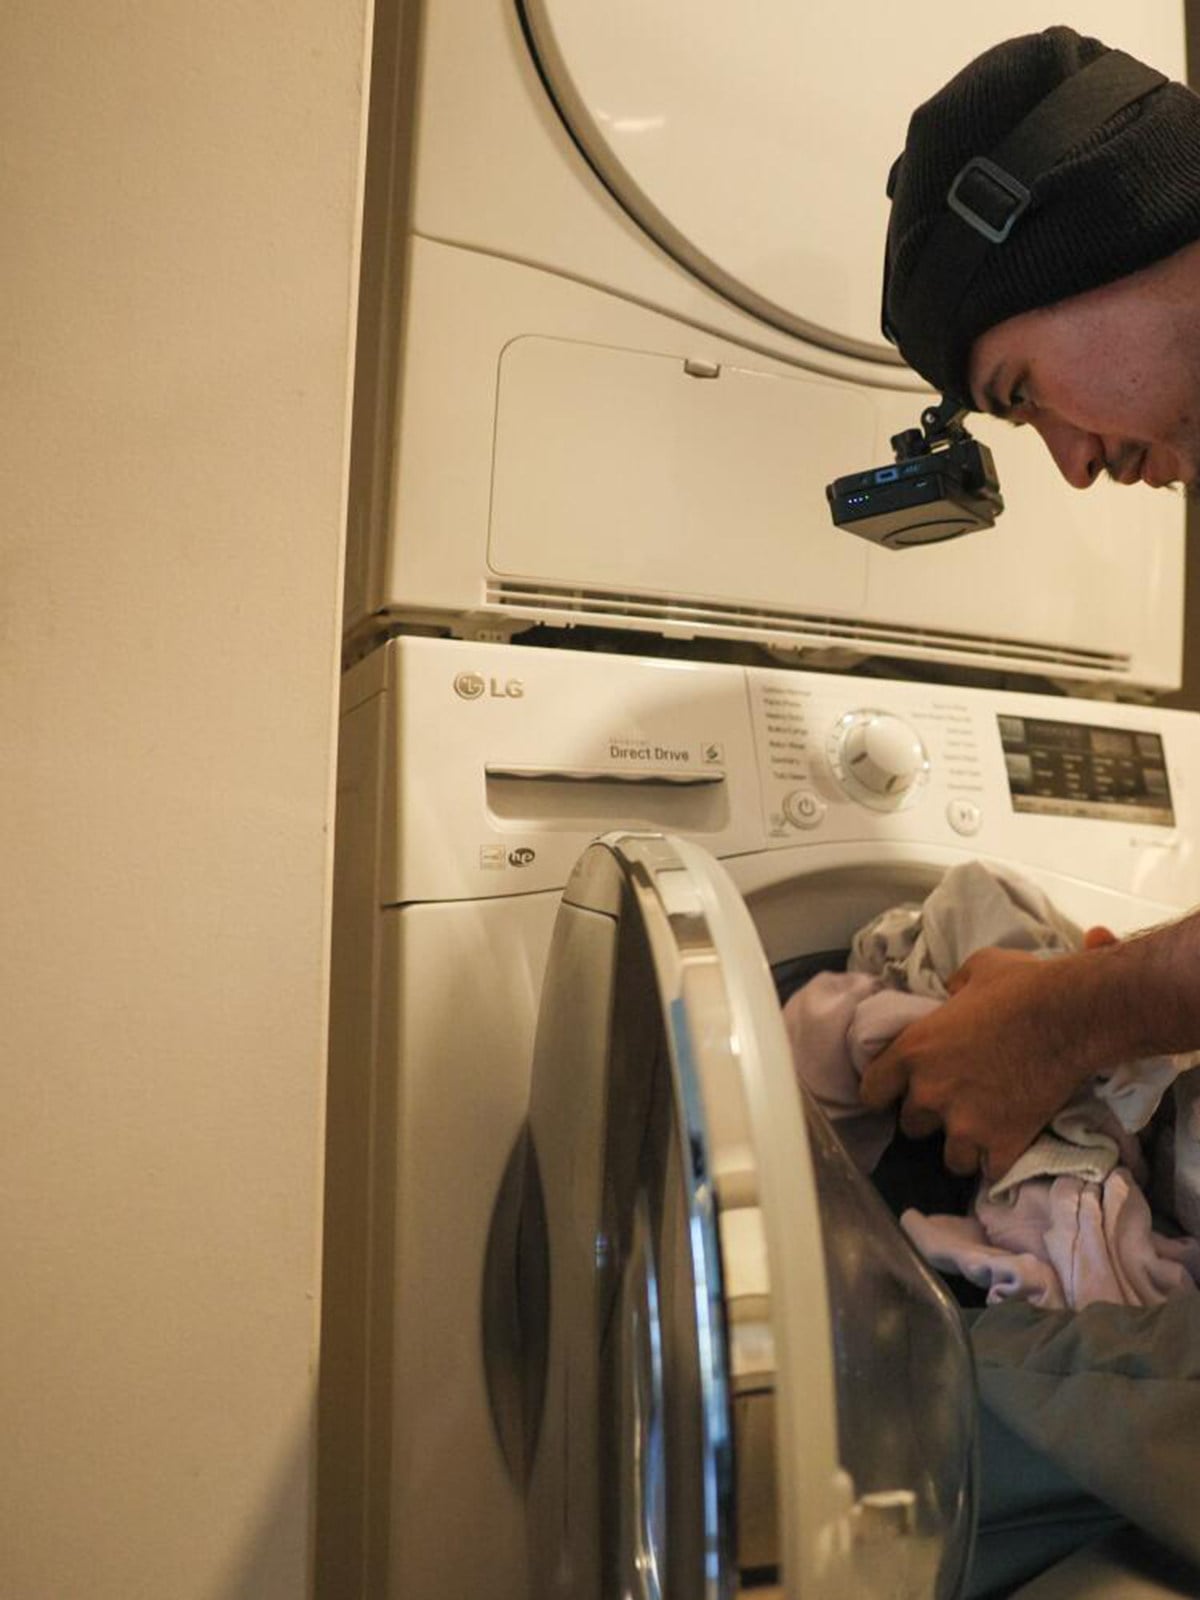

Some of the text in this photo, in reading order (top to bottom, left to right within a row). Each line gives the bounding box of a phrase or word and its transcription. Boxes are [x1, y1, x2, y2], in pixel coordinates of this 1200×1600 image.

[490, 677, 524, 698] LG
[610, 745, 689, 762] Direct Drive
